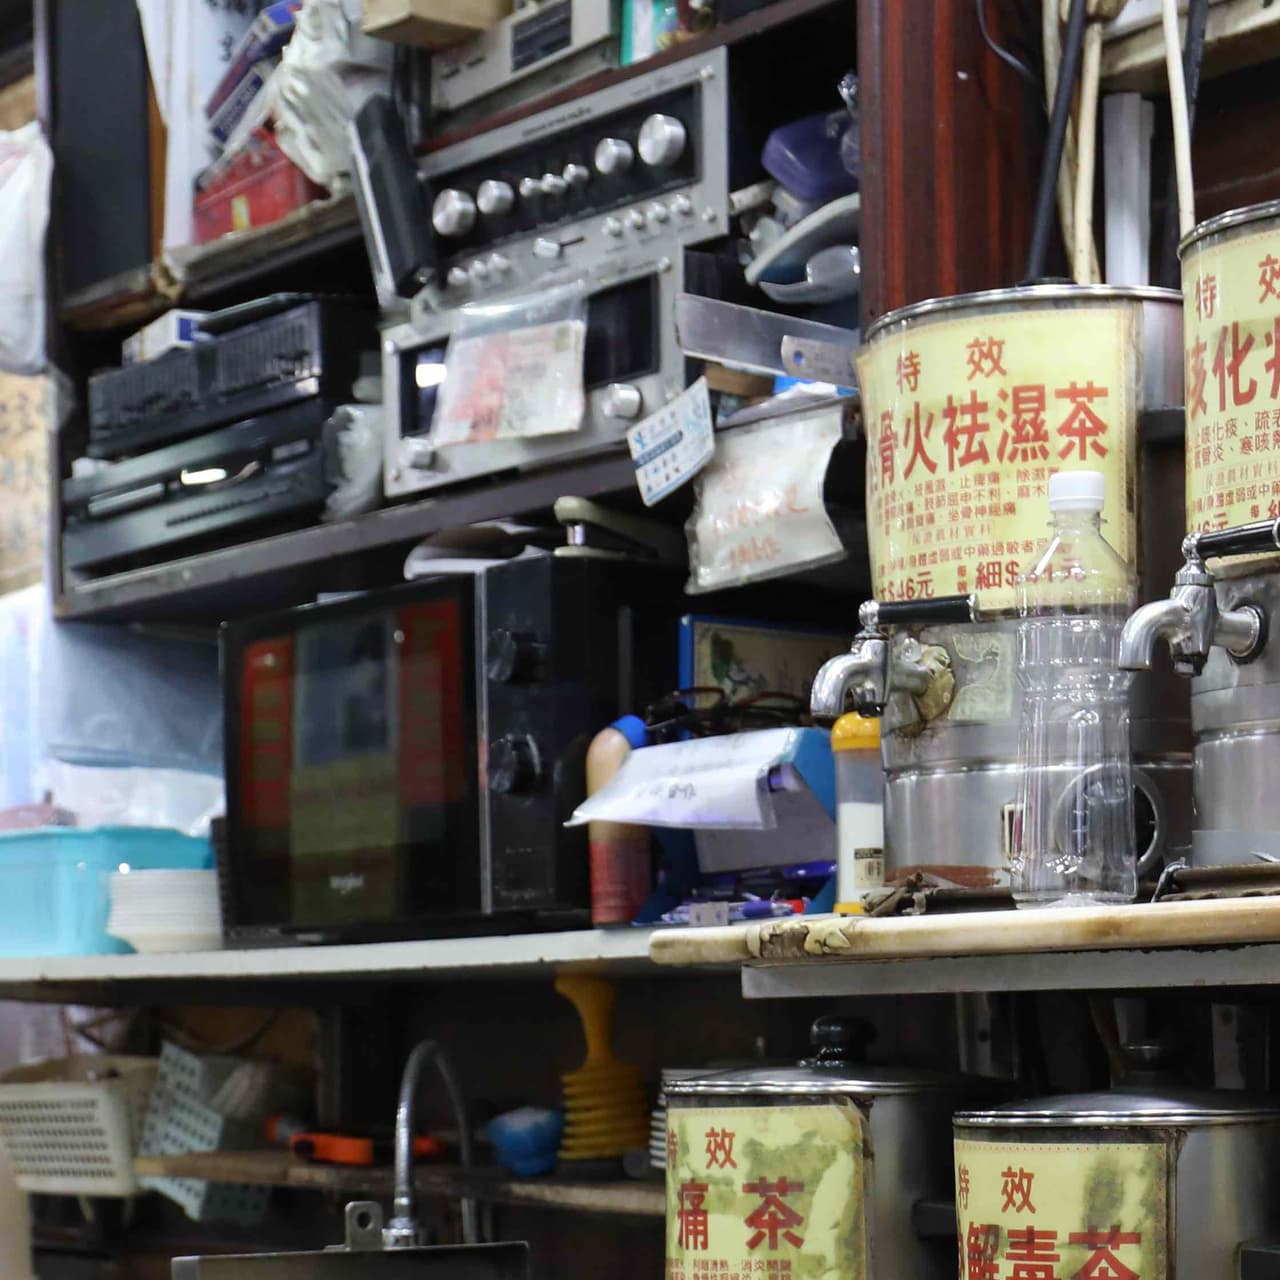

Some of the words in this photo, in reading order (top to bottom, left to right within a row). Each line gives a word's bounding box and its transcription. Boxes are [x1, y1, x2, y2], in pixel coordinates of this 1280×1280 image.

[896, 337, 1007, 393] 特效
[869, 381, 1109, 493] 骨火祛濕茶
[677, 1177, 805, 1251] 痛茶
